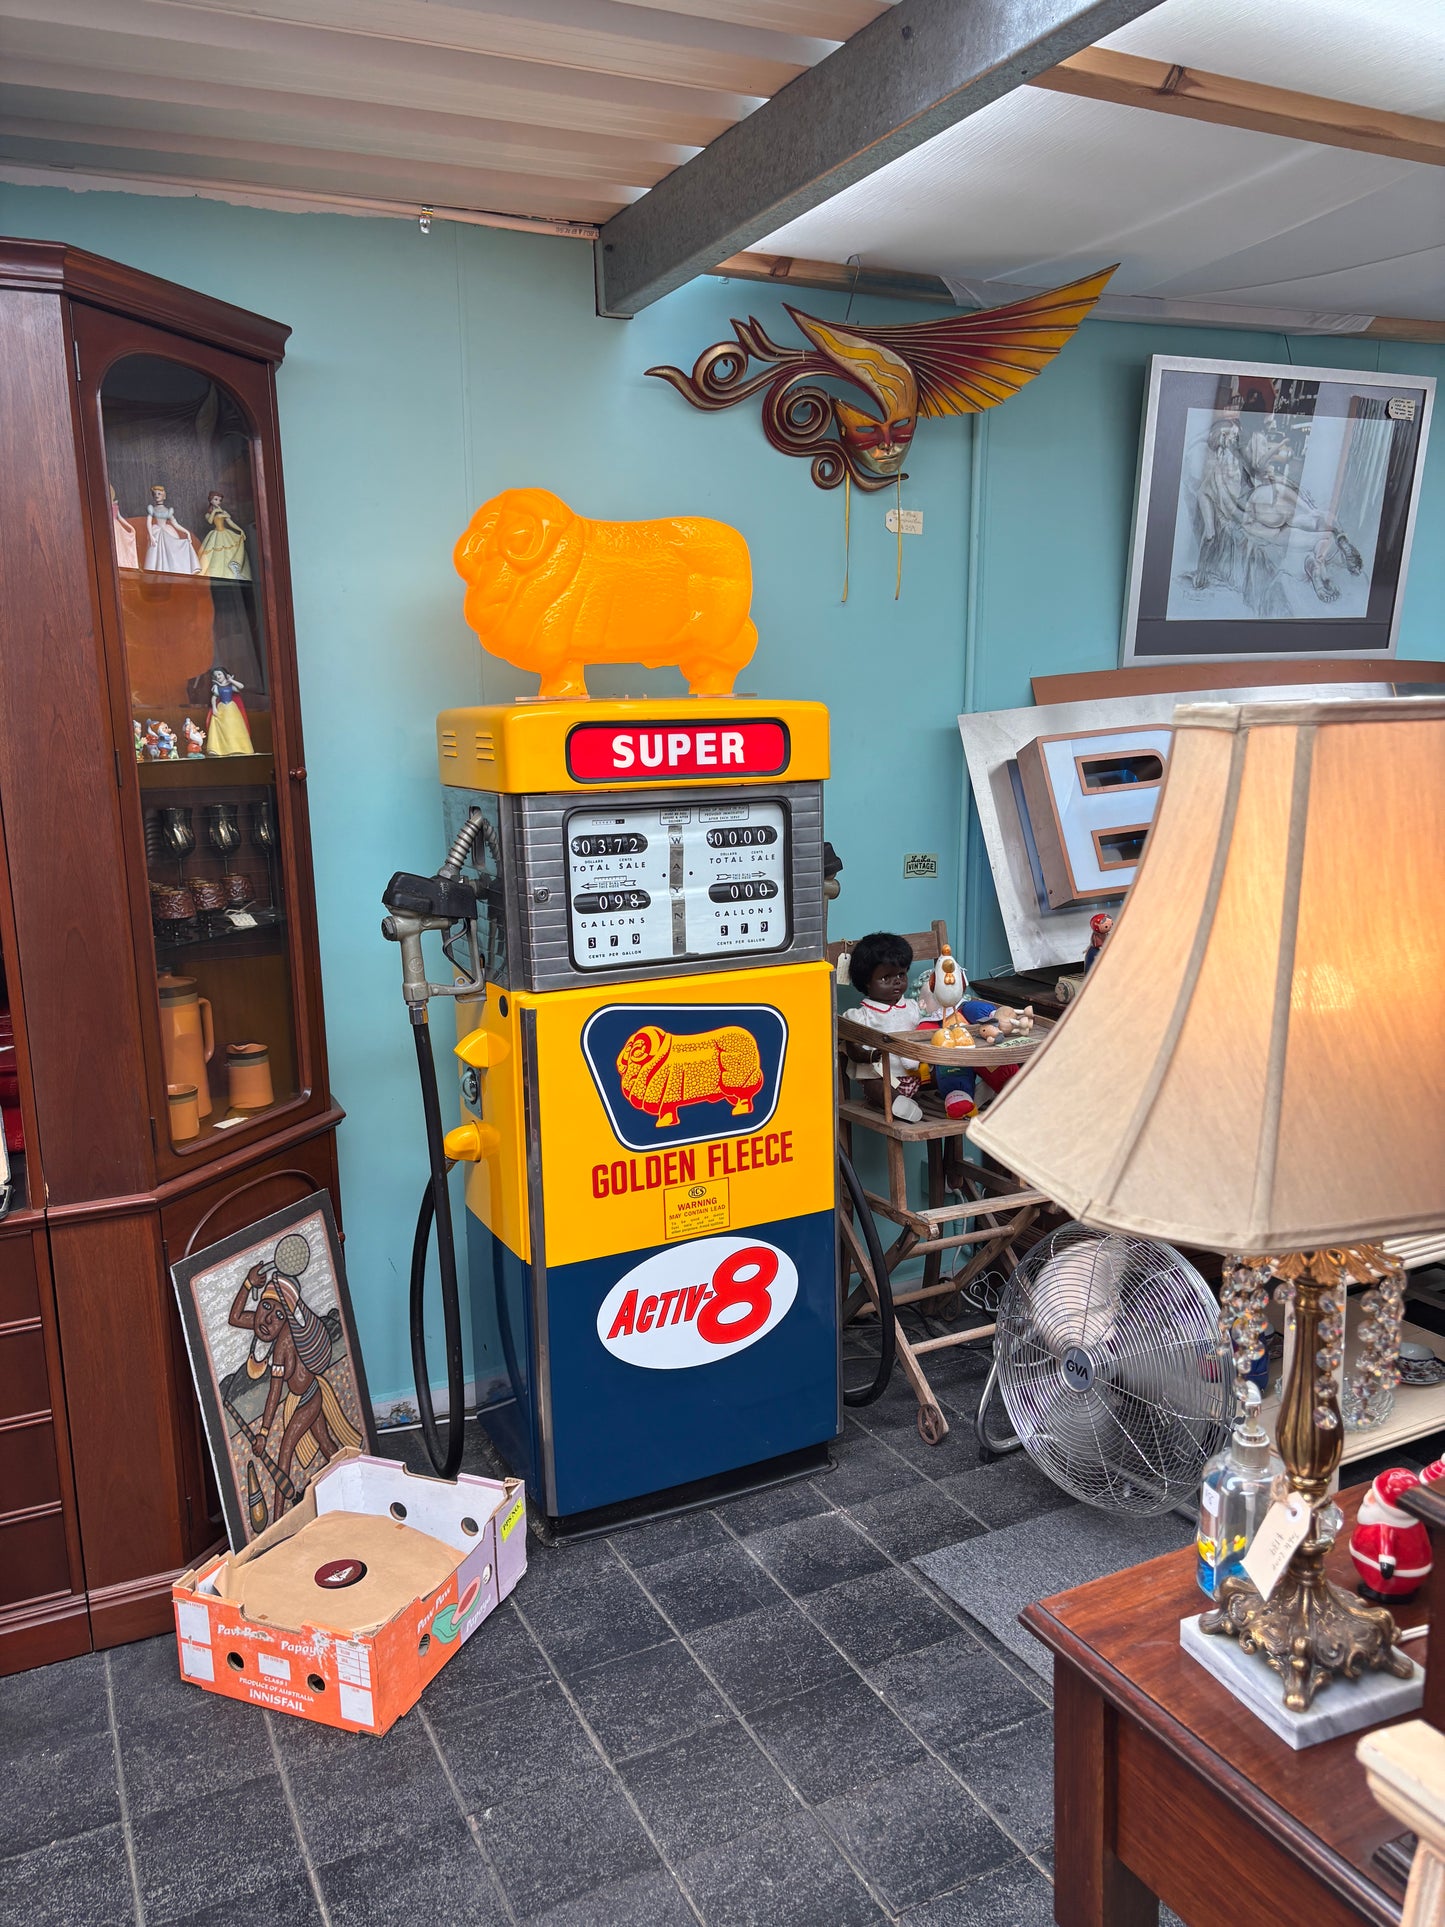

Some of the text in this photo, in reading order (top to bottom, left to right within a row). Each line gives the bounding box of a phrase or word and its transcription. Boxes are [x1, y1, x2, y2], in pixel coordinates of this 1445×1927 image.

[612, 732, 745, 768] SUPER
[709, 853, 775, 865] TOTAL SALE
[572, 862, 646, 873] TOTAL SALE
[908, 862, 934, 870] VINTAGE
[715, 907, 772, 917] GALLONS
[581, 917, 645, 928] GALLONS
[592, 1131, 793, 1199] GOLDEN FLEECE
[678, 1197, 717, 1211] WARNING
[684, 1208, 708, 1217] CONTAIN
[711, 1204, 726, 1212] LEAD
[1066, 1360, 1088, 1380] GVA
[418, 1584, 452, 1635] Paw Paw
[263, 1675, 284, 1686] CLASS
[239, 1677, 314, 1703] PRODUCE OF AUSTRALIA
[249, 1689, 305, 1712] INNISFAIL
